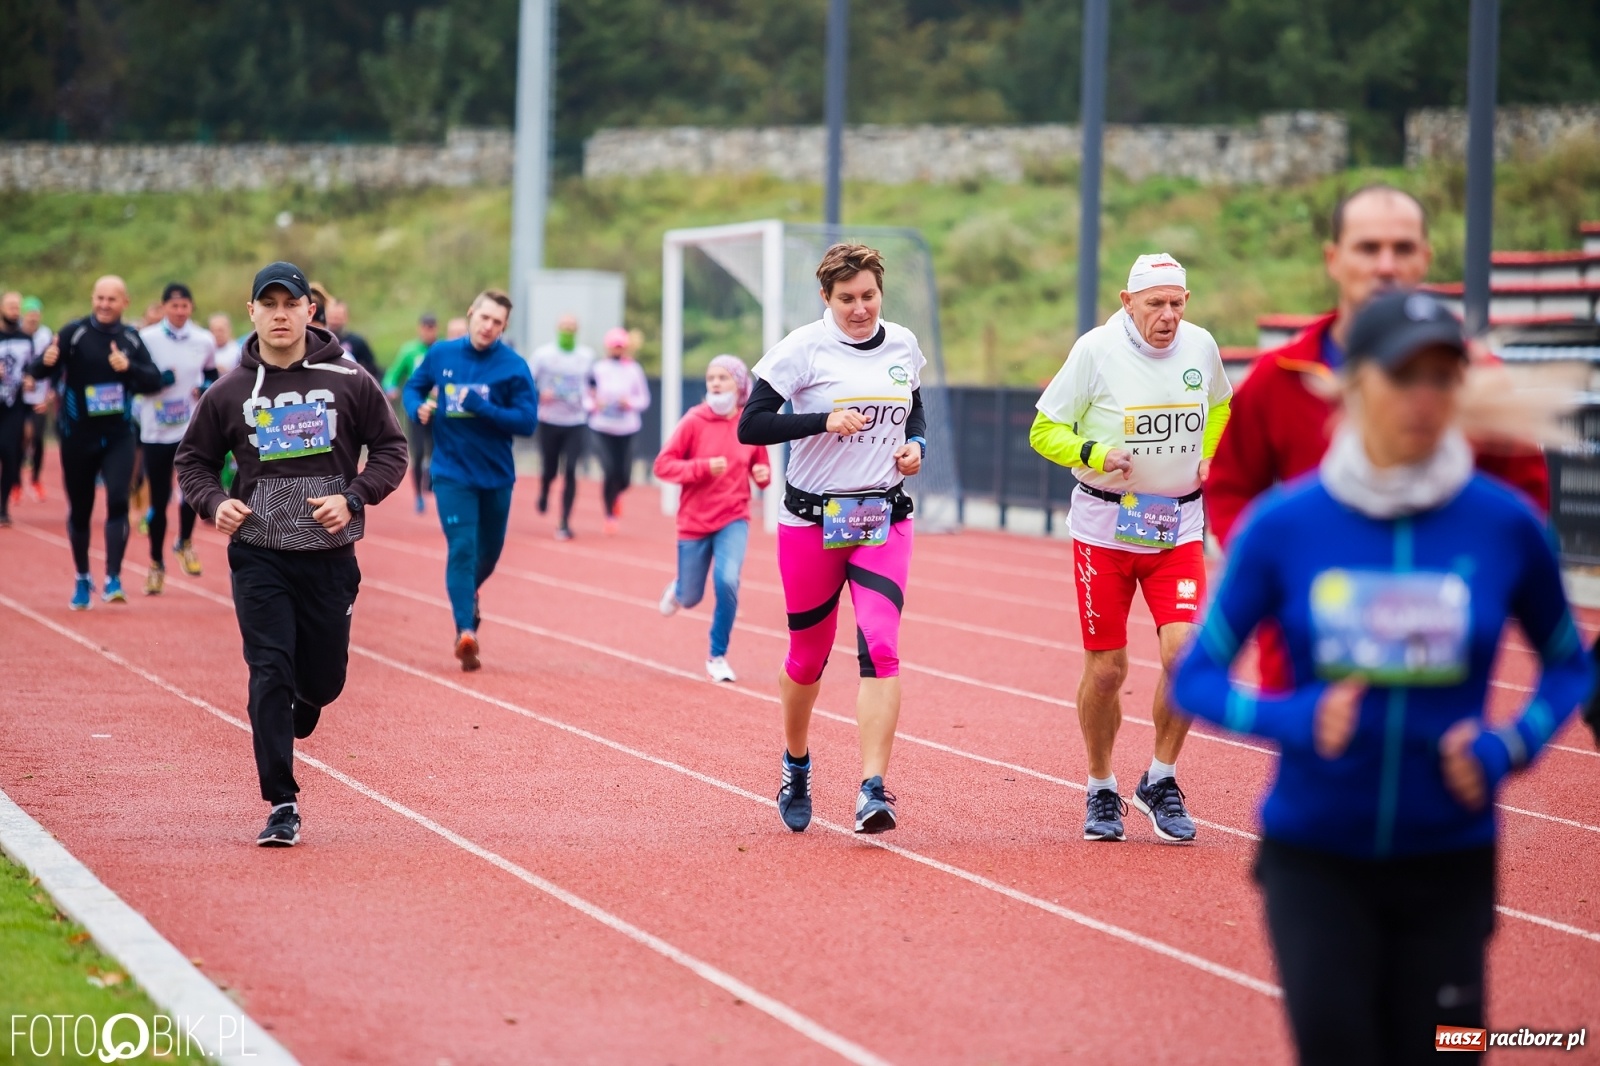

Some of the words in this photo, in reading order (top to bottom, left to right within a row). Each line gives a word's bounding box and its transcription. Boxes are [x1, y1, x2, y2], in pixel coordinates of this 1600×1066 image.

[266, 425, 280, 433] BIEG
[1136, 403, 1205, 444] agrol
[303, 436, 325, 448] 301
[1132, 444, 1196, 456] KIETRZ
[832, 516, 846, 524] BIEG
[1127, 510, 1141, 518] BIEG
[1144, 513, 1156, 521] DLA
[859, 528, 882, 539] 256
[1154, 530, 1175, 541] 255
